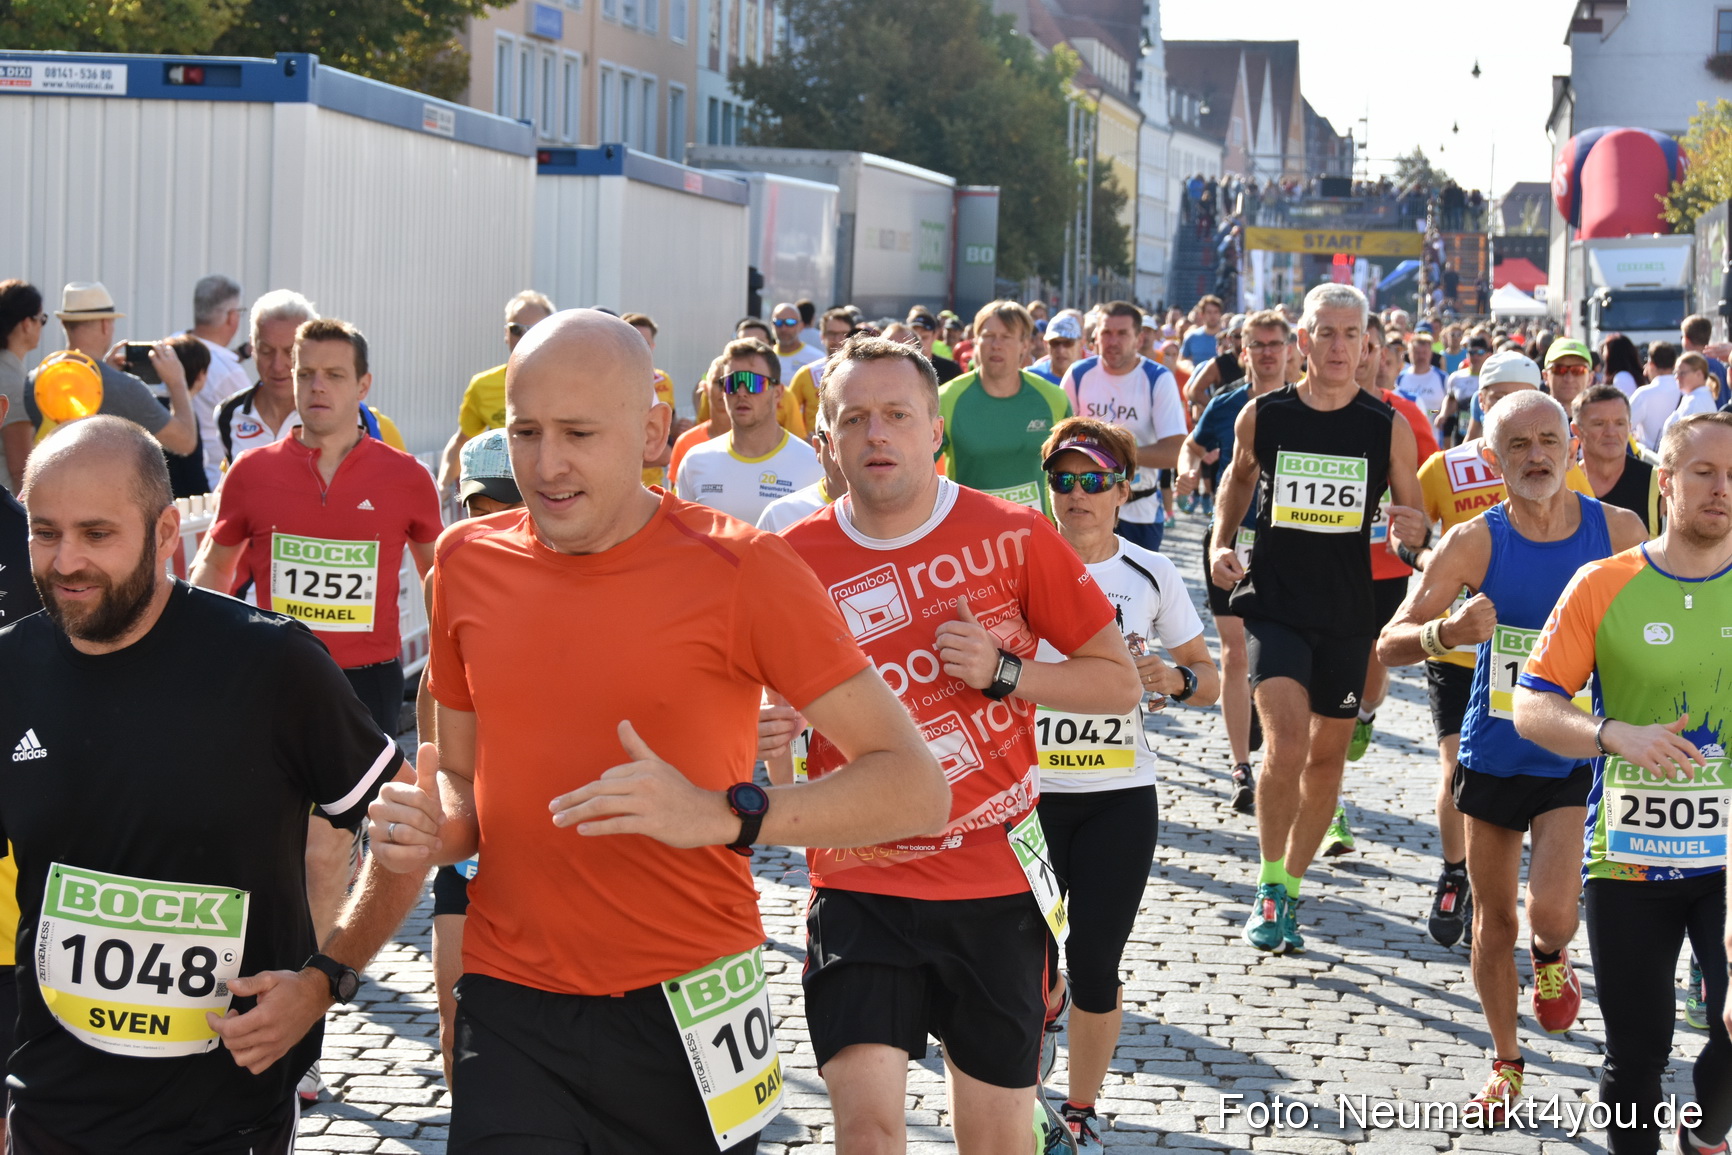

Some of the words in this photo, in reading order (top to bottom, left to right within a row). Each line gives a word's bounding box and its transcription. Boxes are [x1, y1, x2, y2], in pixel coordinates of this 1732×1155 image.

[1303, 233, 1364, 250] START
[1284, 456, 1357, 478] BOCK
[761, 473, 777, 485] 20
[1286, 481, 1355, 508] 1126
[1291, 511, 1345, 524] RUDOLF
[282, 540, 366, 563] BOCK
[285, 568, 363, 600] 1252
[834, 570, 894, 600] raumbox
[286, 603, 356, 621] MICHAEL
[1037, 717, 1123, 747] 1042
[12, 748, 48, 762] adidas
[1049, 753, 1106, 767] SILVIA
[1620, 794, 1721, 830] 2505
[1629, 837, 1711, 856] MANUEL
[62, 879, 225, 926] BOCK
[61, 933, 219, 998] 1048
[88, 1007, 171, 1036] SVEN
